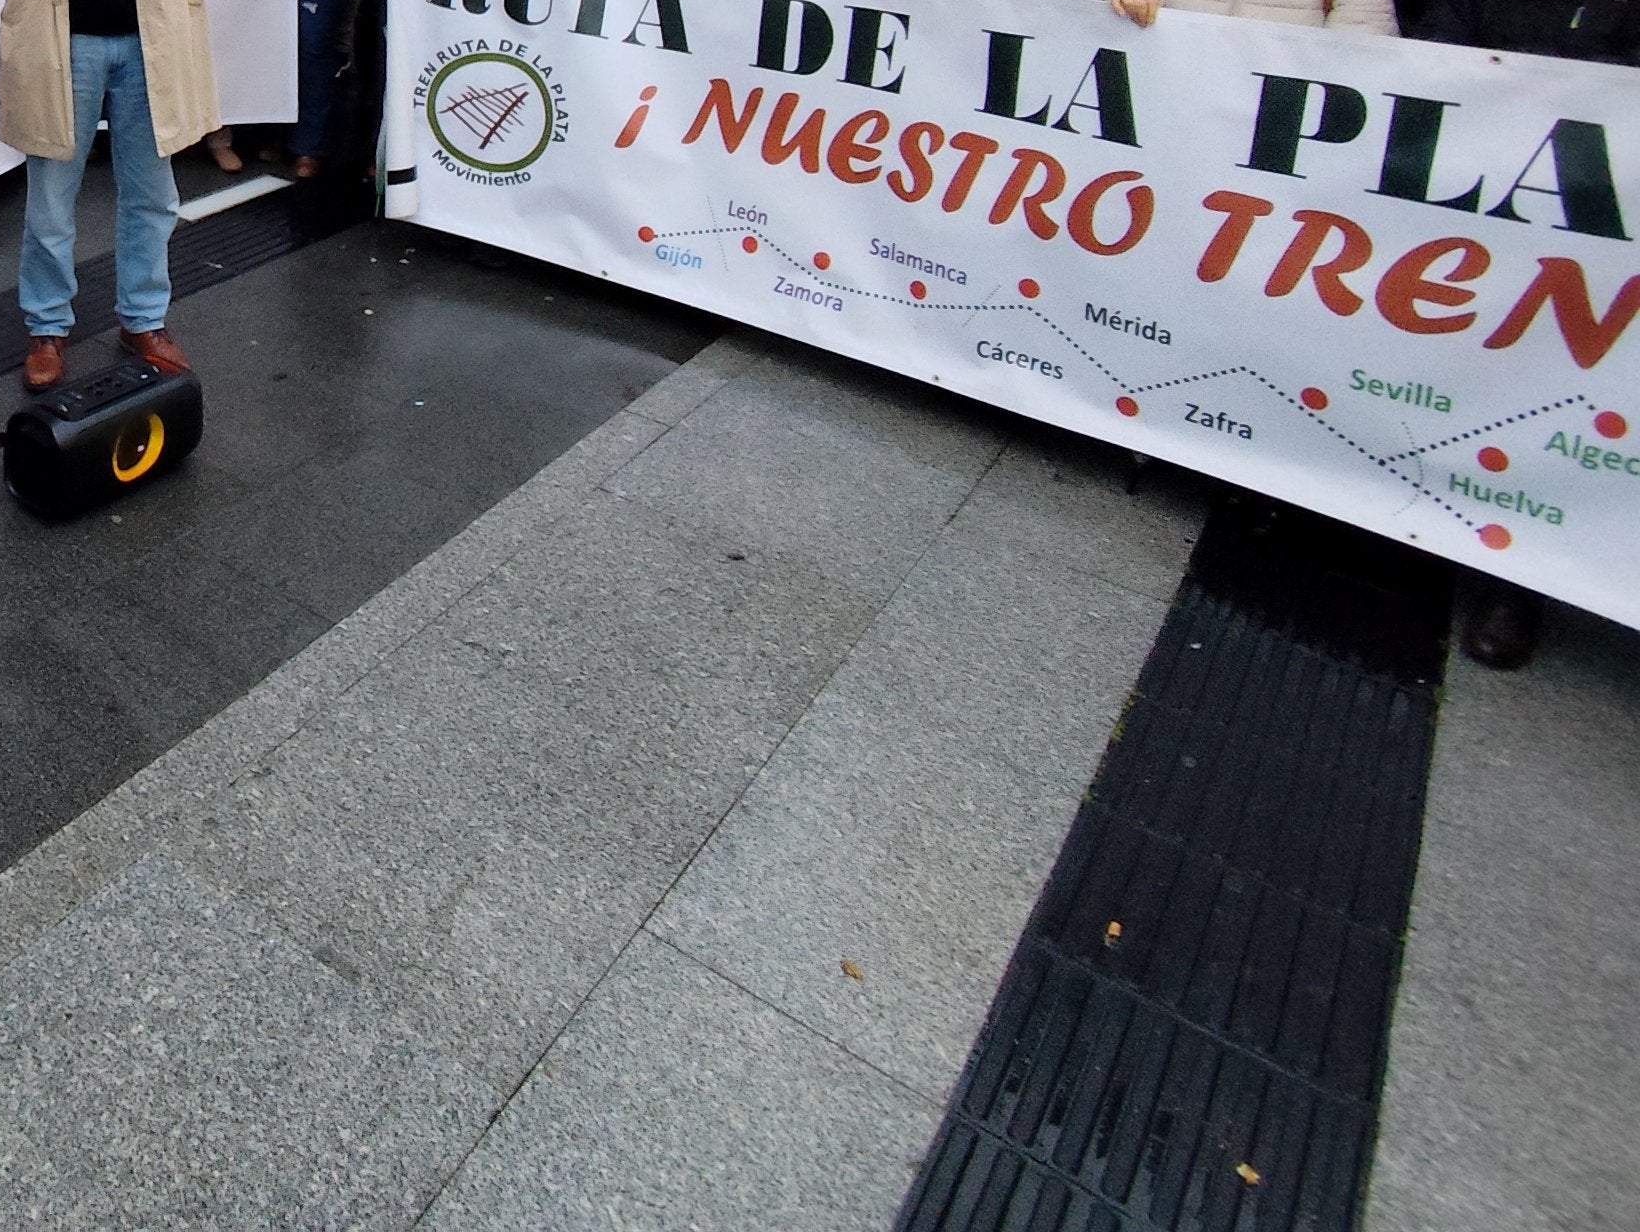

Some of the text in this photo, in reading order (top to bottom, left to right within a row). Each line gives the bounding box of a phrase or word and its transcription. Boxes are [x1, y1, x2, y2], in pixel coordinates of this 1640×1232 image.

[413, 39, 569, 143] TREN RUTA DE LA PLATA
[974, 29, 1142, 148] LA
[1235, 72, 1633, 241] PLA
[432, 149, 532, 186] Movimiento
[727, 200, 768, 226] León
[655, 244, 702, 269] Gijón
[869, 238, 967, 286] Salamanca
[773, 276, 844, 312] Zamora
[1196, 191, 1640, 370] TREN
[1084, 302, 1171, 345] Mérida
[976, 340, 1064, 380] Cáceres
[1349, 369, 1452, 413] Sevilla
[1184, 402, 1253, 440] Zafra
[1449, 473, 1565, 526] Huelva
